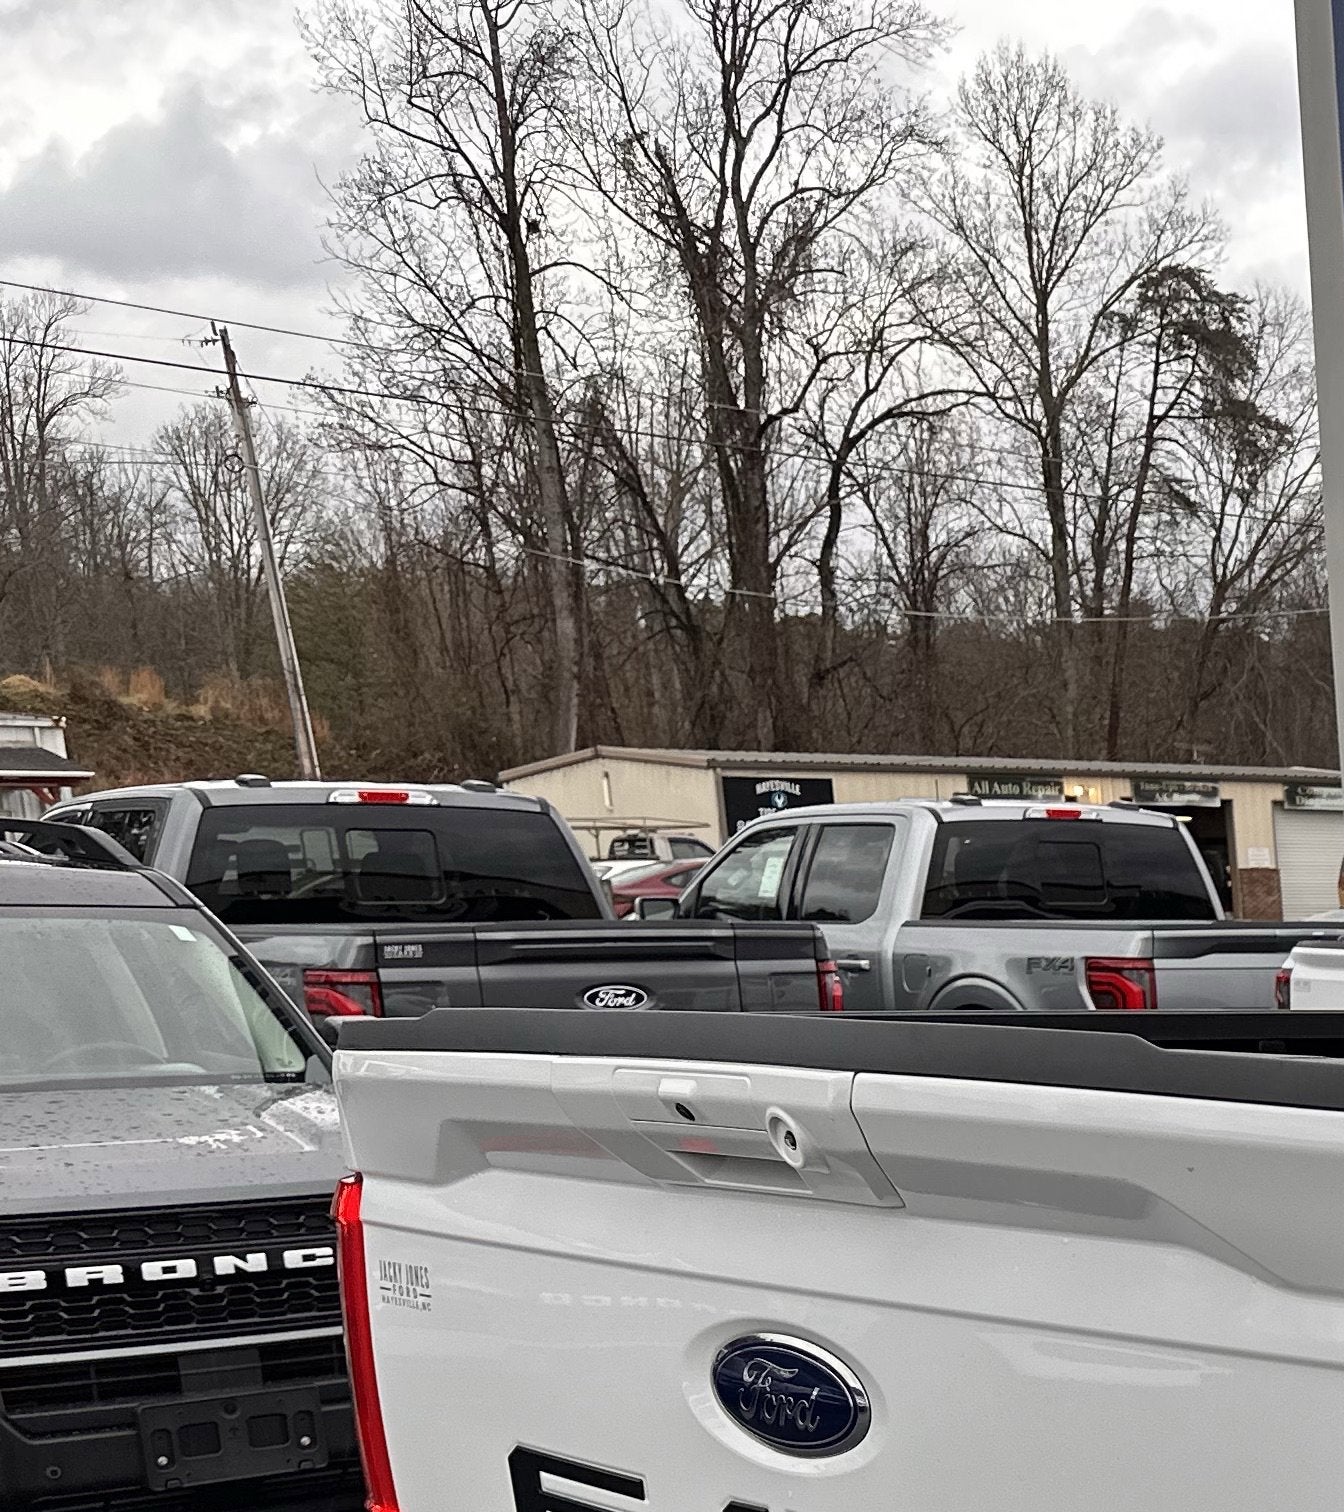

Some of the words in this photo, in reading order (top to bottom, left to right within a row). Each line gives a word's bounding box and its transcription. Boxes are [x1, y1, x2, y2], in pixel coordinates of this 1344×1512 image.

[972, 781, 990, 795] All
[991, 782, 1020, 795] Auto
[1022, 781, 1061, 798] Repair
[1025, 956, 1075, 975] FX4
[595, 989, 637, 1007] Ford
[0, 1247, 335, 1293] BRONC
[379, 1259, 402, 1284] JACKY
[405, 1264, 430, 1289] JONES
[738, 1357, 821, 1433] Ford
